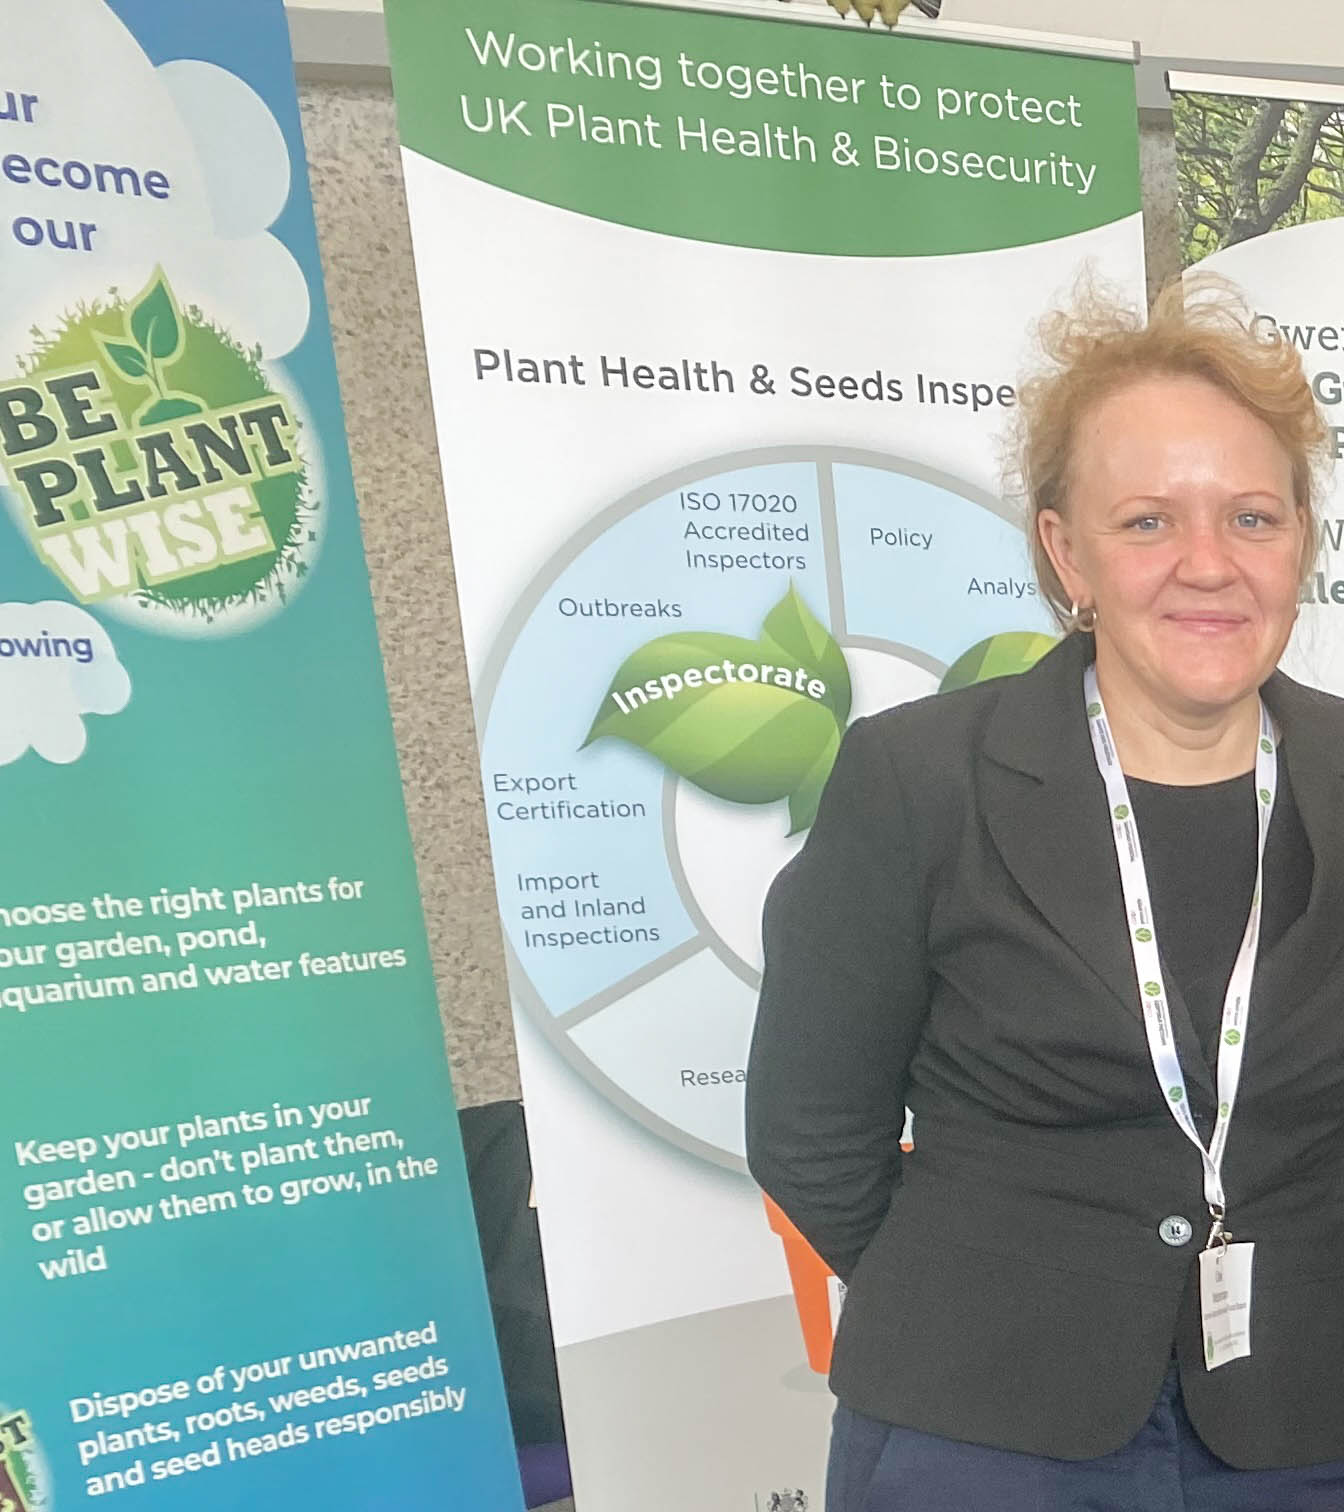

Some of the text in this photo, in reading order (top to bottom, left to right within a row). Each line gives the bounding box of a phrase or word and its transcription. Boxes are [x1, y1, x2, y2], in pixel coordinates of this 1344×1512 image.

[465, 27, 1083, 128] Working together to protect
[460, 95, 1097, 194] UK Plant Health & Biosecurity
[473, 348, 586, 386] Plant
[601, 356, 735, 393] Health
[750, 365, 776, 395] &
[790, 367, 903, 403] Seeds
[1, 371, 117, 456] BE
[14, 403, 292, 527] PLANT
[680, 492, 798, 513] ISO 17020
[42, 486, 268, 594] WISE
[684, 521, 810, 543] Accredited
[870, 526, 933, 551] Policy
[686, 549, 807, 572] Inspectors
[558, 597, 683, 619] Outbreaks
[612, 658, 828, 713] Inspectorate
[493, 772, 578, 794] Export
[497, 801, 647, 821] Certification
[518, 871, 600, 894] Import
[521, 897, 647, 920] and Inland
[525, 926, 660, 949] Inspections
[69, 1321, 437, 1424] Dispose of your unwanted
[78, 1356, 449, 1465] plants, roots, weeds, seeds
[86, 1384, 466, 1496] and seed heads responsibly
